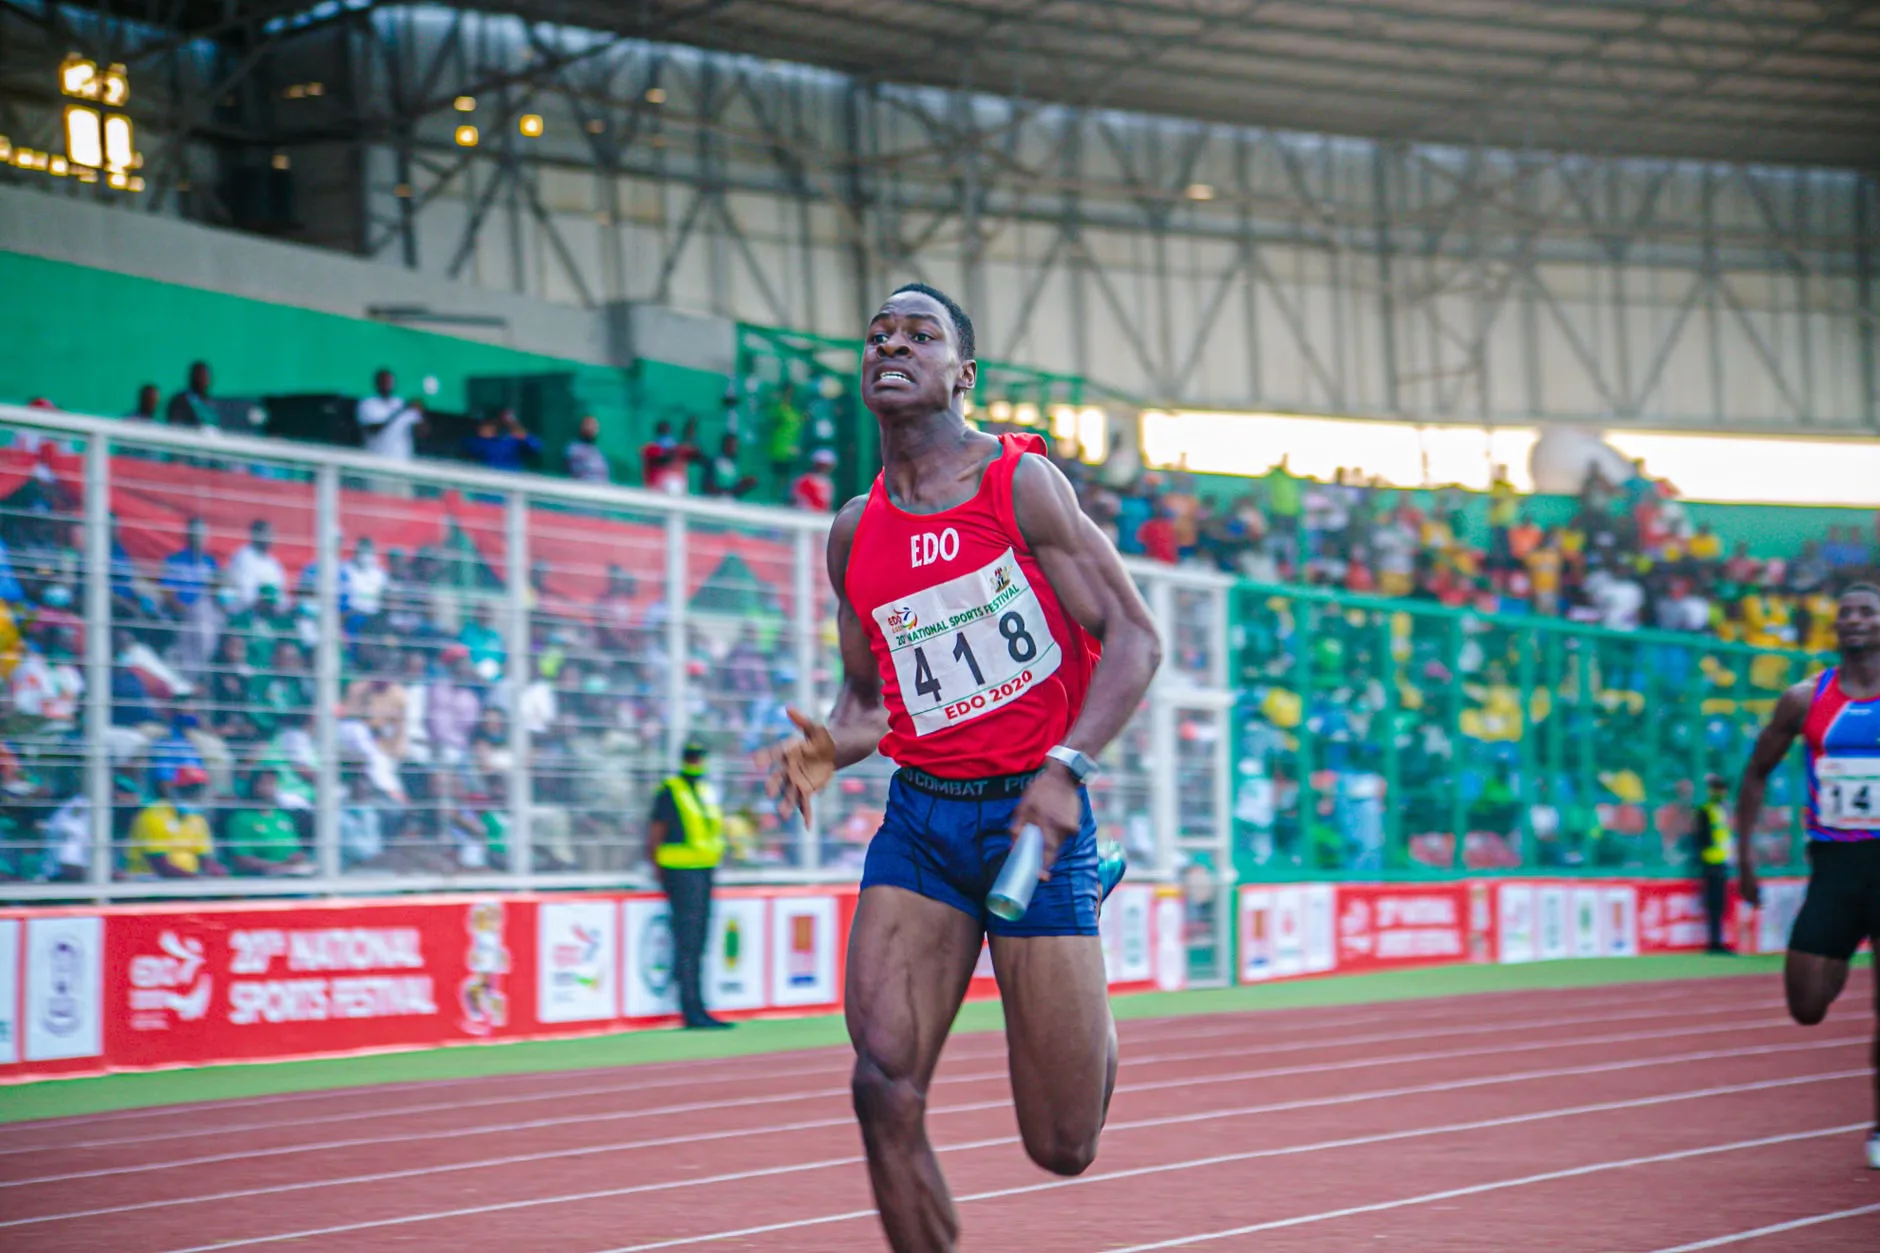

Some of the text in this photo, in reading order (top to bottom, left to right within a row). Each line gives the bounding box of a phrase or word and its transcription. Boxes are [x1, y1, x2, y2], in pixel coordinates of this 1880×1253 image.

[910, 527, 960, 568] EDO
[907, 620, 949, 641] NATIONAL
[949, 606, 983, 627] SPORTS
[983, 584, 1020, 615] FESTIVAL
[914, 610, 1038, 702] 418
[943, 669, 1033, 720] EDO 2020
[915, 771, 988, 796] COMBAT
[288, 926, 425, 971] NATIONAL
[228, 974, 438, 1025] SPORTS FESTIVAL
